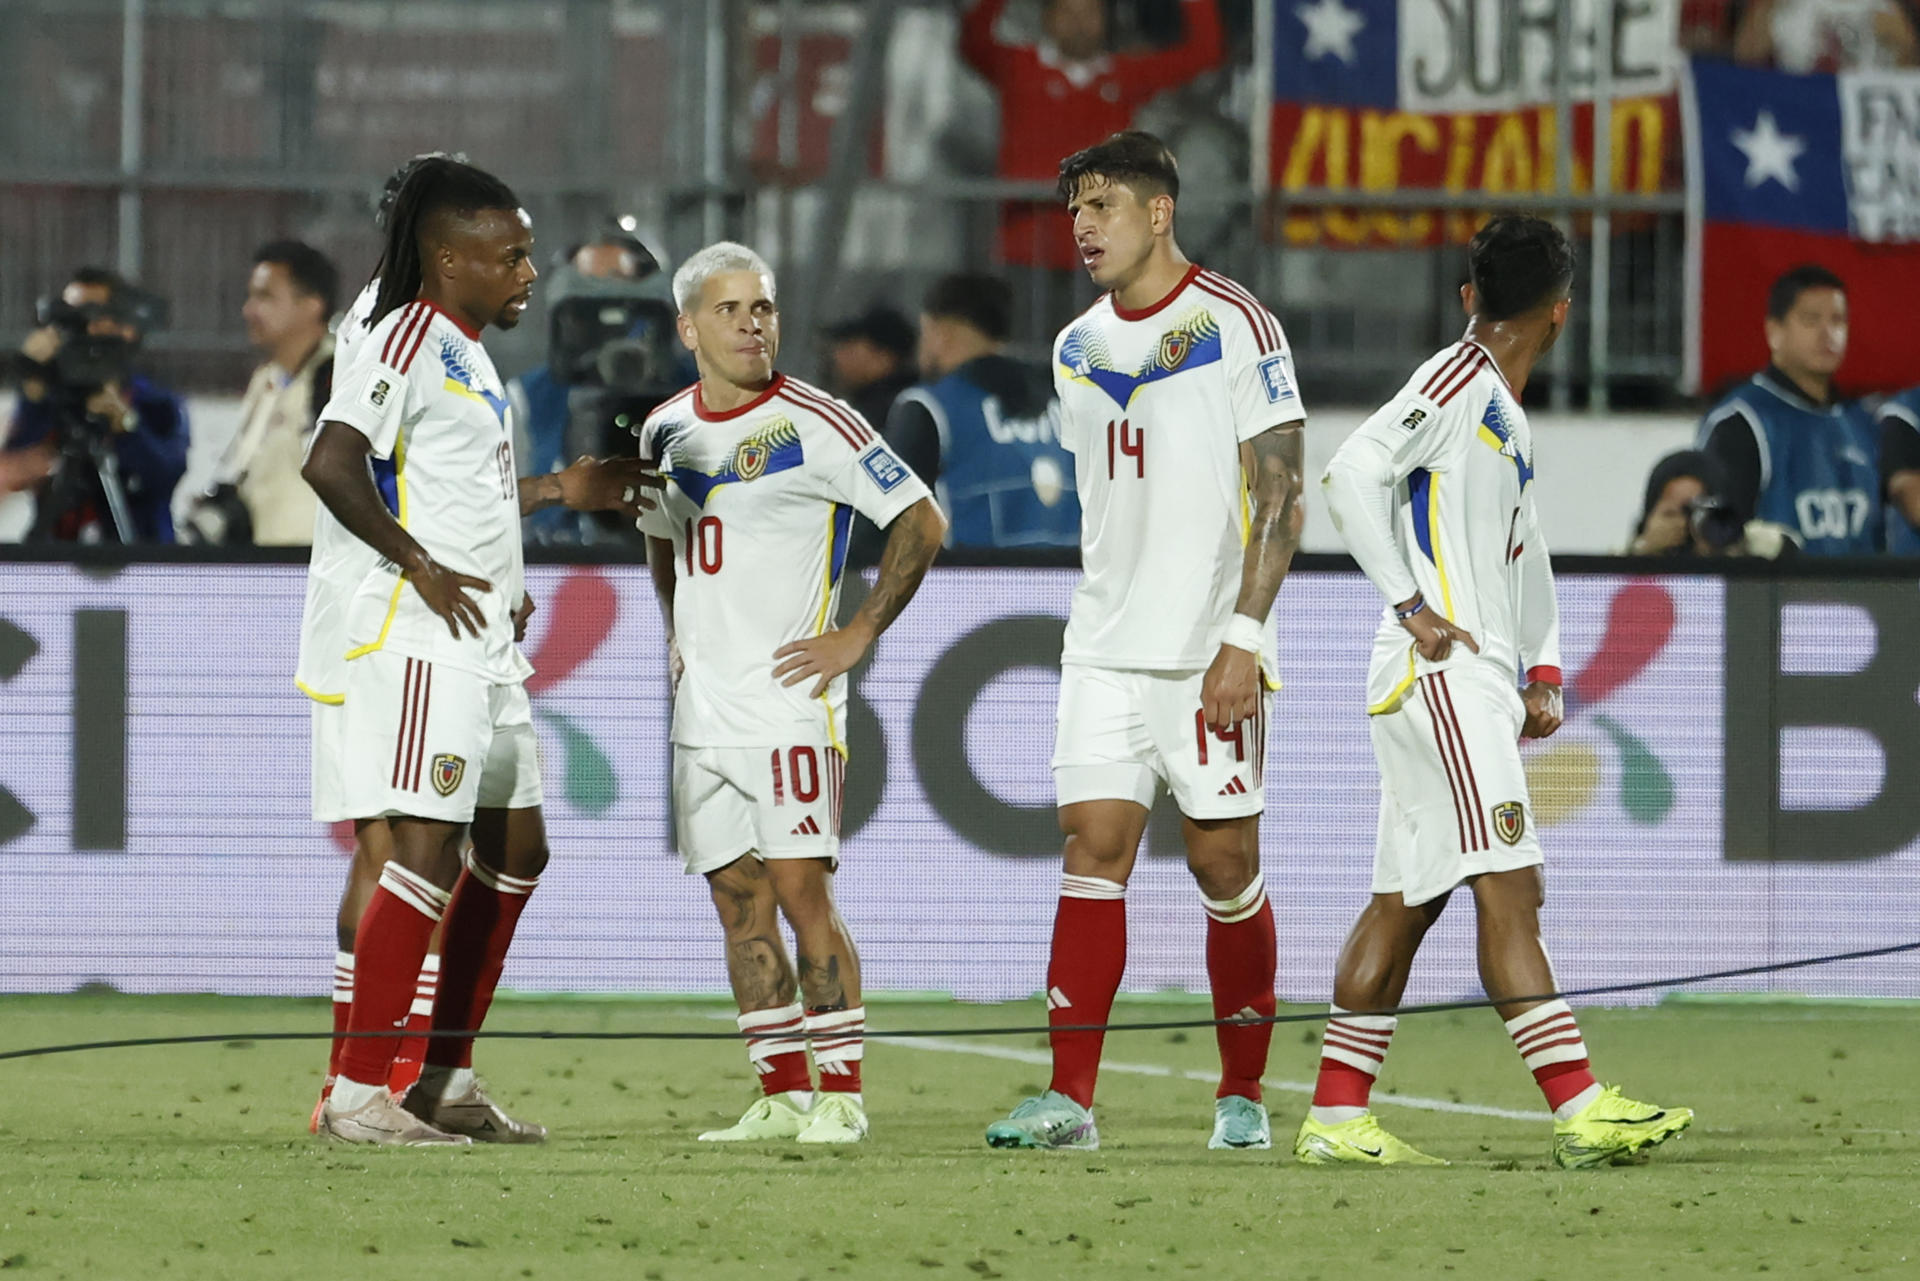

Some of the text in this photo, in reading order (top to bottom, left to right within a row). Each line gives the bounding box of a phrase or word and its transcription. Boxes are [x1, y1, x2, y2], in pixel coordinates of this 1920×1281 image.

[496, 440, 514, 500] 18
[1107, 418, 1144, 480] 14
[685, 515, 722, 576] 10
[771, 746, 819, 806] 10
